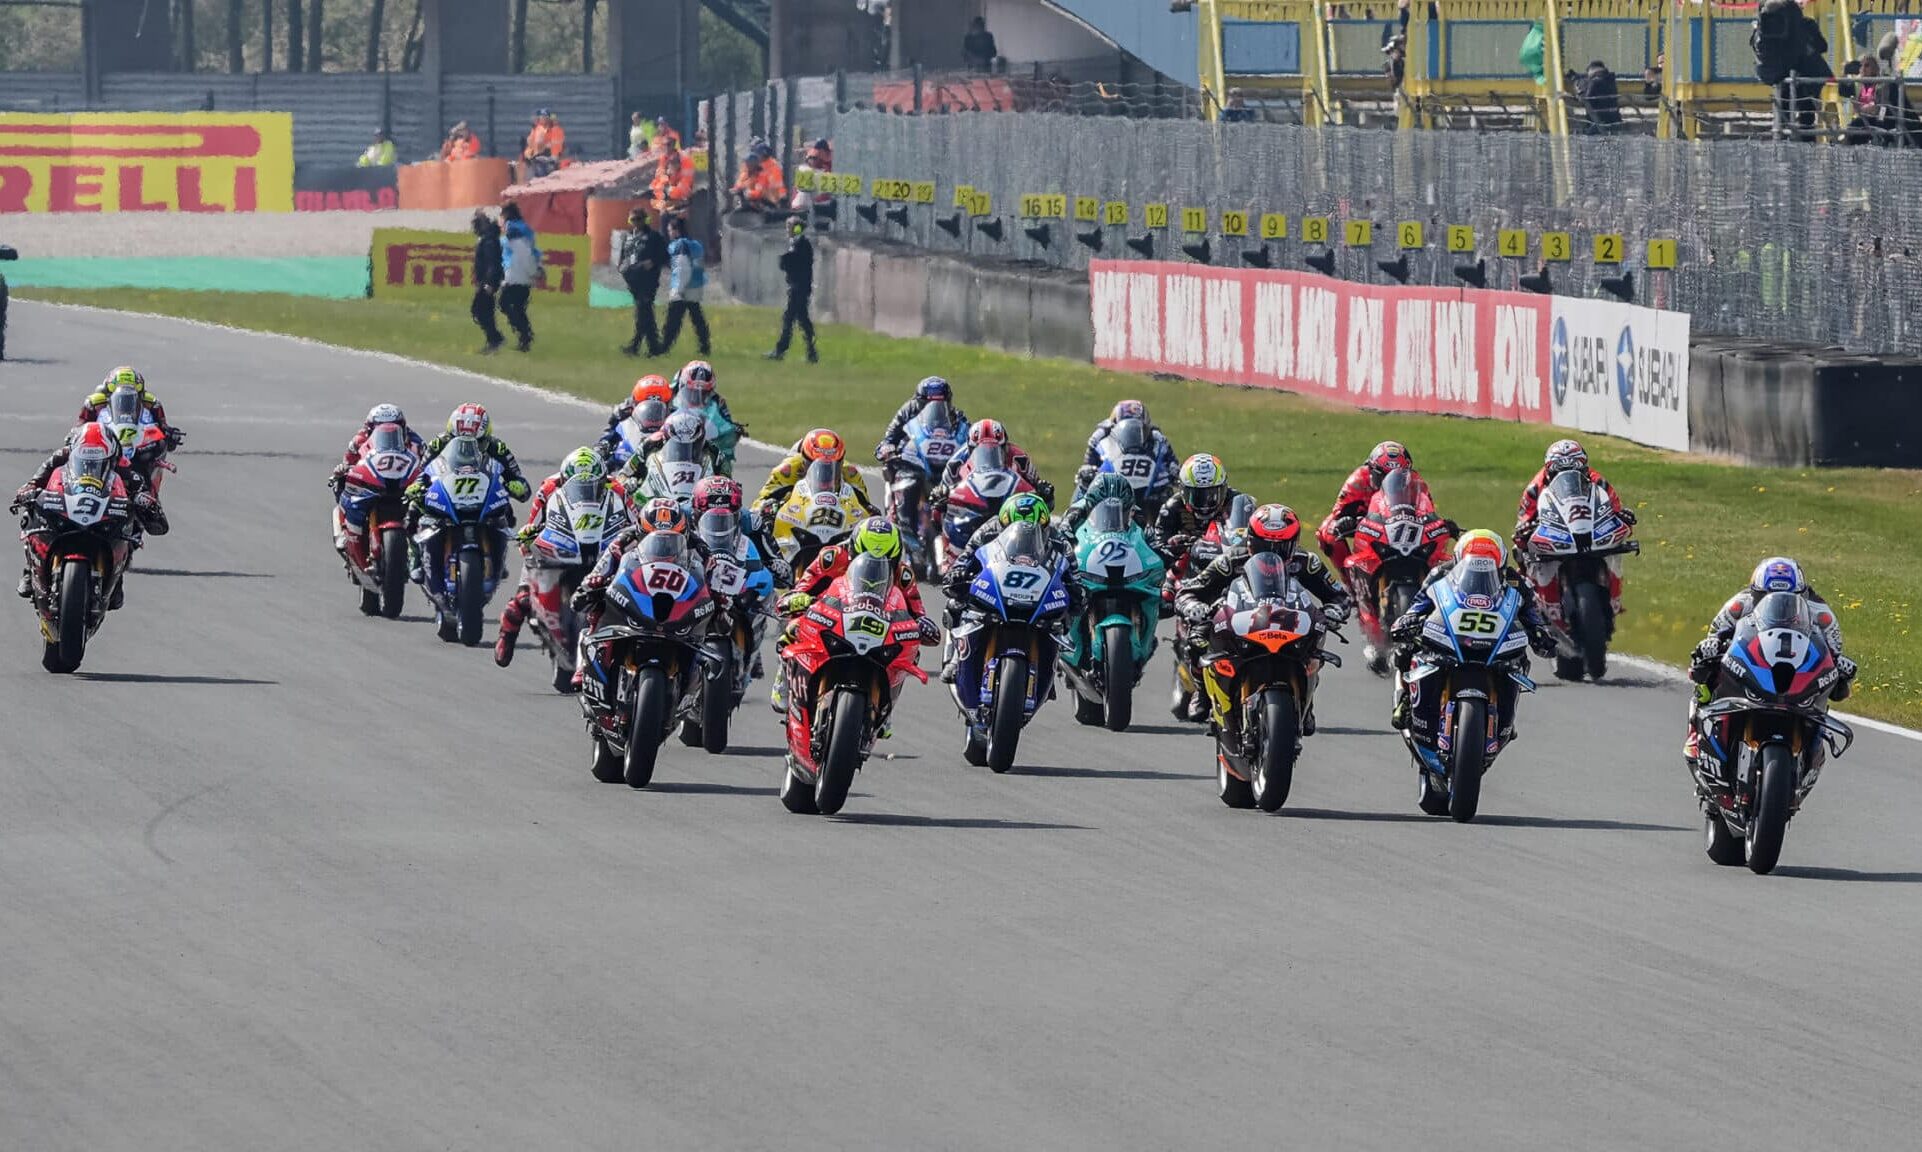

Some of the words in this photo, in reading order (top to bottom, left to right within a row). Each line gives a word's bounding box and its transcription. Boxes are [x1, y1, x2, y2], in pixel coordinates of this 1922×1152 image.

[892, 183, 911, 198] 20
[970, 196, 986, 214] 17
[1025, 198, 1042, 216] 16
[1046, 199, 1062, 216] 15
[1107, 205, 1125, 223] 13
[1149, 207, 1164, 226] 12
[1187, 212, 1202, 229] 11
[1224, 214, 1242, 233] 10
[1267, 216, 1278, 237] 9
[1310, 220, 1323, 241] 8
[1354, 223, 1366, 245] 7
[1404, 223, 1416, 246] 6
[1455, 227, 1467, 250] 5
[1506, 232, 1519, 255] 4
[1551, 235, 1564, 257] 3
[1601, 237, 1616, 260] 2
[1656, 244, 1664, 265] 1
[387, 243, 575, 293] PIRLI
[376, 454, 410, 472] 97
[1120, 458, 1151, 478] 99
[454, 477, 480, 494] 77
[668, 470, 696, 487] 31
[73, 496, 101, 516] 9
[1393, 523, 1419, 543] 11
[650, 568, 686, 593] 60
[1003, 571, 1041, 589] 87
[807, 610, 833, 627] Lenovo
[843, 600, 891, 620] aruba.it
[1458, 612, 1498, 634] 55
[894, 631, 920, 641] Lenovo
[1267, 632, 1288, 640] Beta
[1774, 632, 1797, 659] 1
